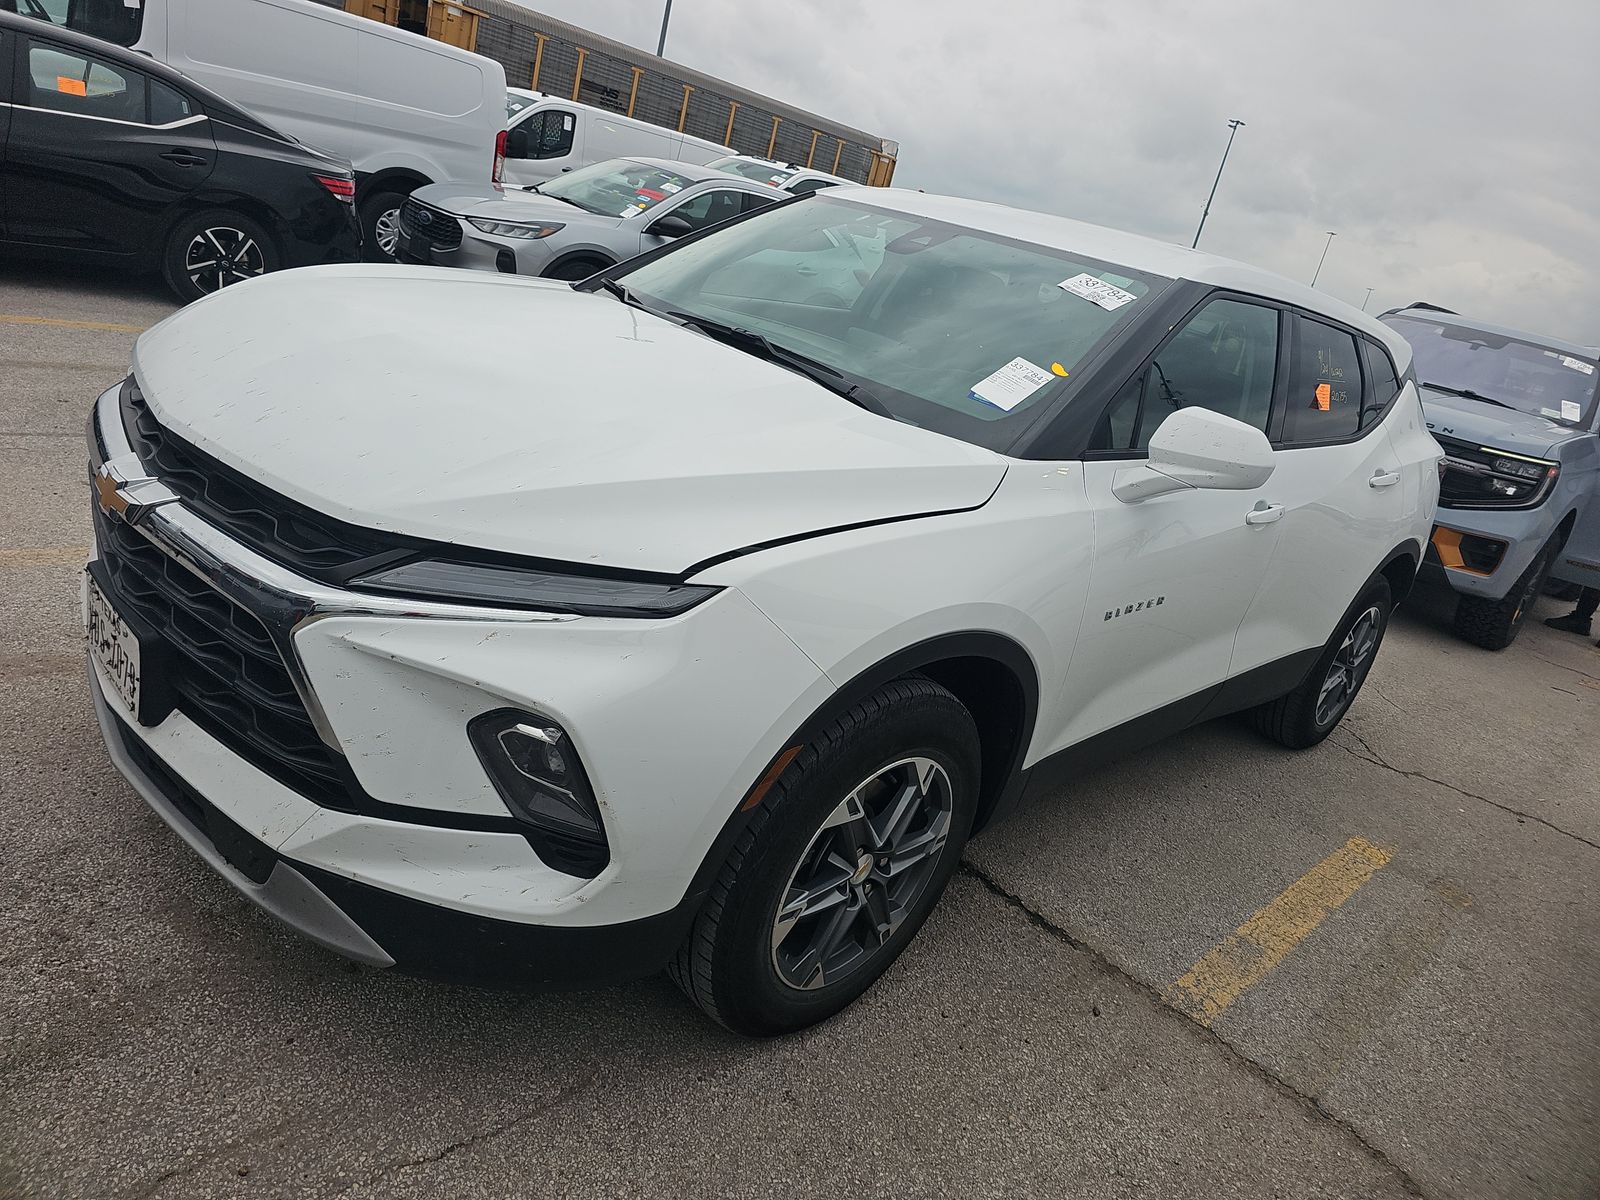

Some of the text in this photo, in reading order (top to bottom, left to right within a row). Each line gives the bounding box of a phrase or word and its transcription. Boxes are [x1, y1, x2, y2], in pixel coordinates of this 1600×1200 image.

[1079, 277, 1134, 303] 3377847
[1010, 361, 1050, 383] 3377847
[1103, 596, 1165, 622] BLAZER
